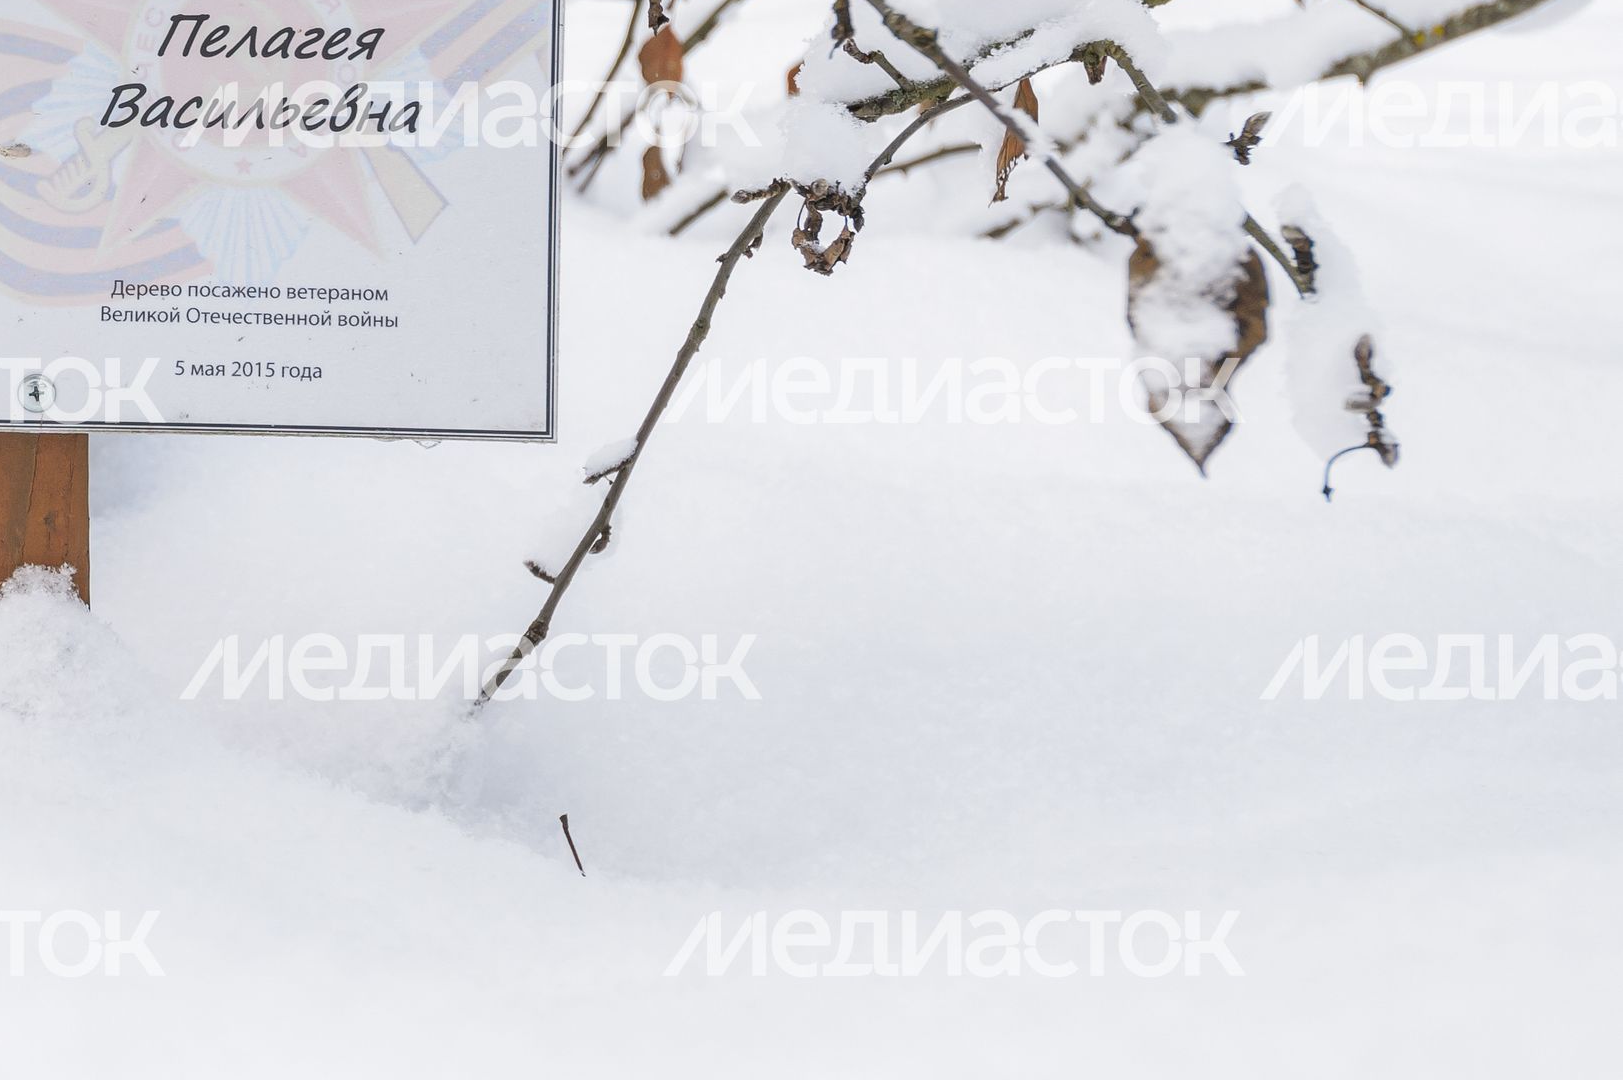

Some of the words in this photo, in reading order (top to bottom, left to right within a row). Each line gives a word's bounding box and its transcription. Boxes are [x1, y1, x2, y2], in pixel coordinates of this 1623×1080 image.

[156, 13, 385, 60] Пелагея
[100, 82, 422, 133] Васильевна
[110, 279, 182, 303] Дерево
[188, 283, 281, 299] посажено
[287, 284, 388, 303] ветераном
[100, 305, 180, 324] Великой
[186, 306, 331, 327] Отечественной
[337, 310, 398, 328] войны
[175, 360, 185, 376] 5
[191, 363, 225, 377] мая
[232, 361, 275, 378] 2015
[281, 365, 322, 381] года
